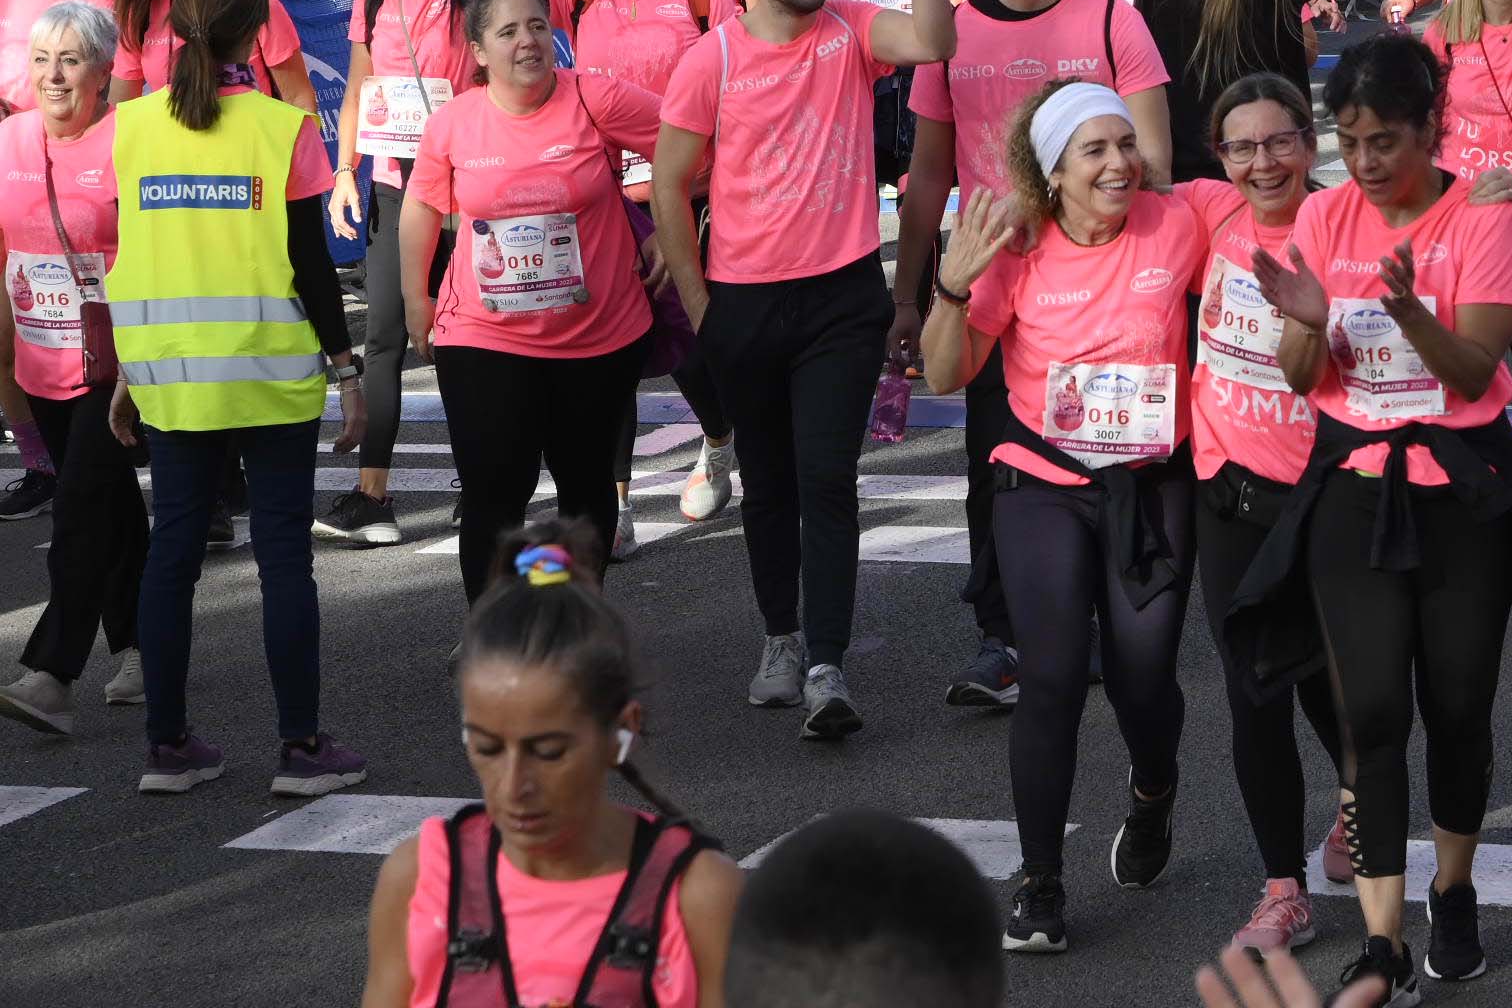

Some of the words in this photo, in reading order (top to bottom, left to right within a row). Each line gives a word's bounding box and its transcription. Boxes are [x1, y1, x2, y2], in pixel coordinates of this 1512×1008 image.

[816, 32, 850, 61] DKV
[1057, 56, 1099, 72] DKV
[726, 74, 779, 93] OYSHO
[464, 155, 505, 168] OYSHO
[141, 184, 248, 203] VOLUNTARIS
[505, 232, 543, 243] ASTURIANA
[508, 254, 544, 269] 016
[516, 272, 538, 281] 7685
[36, 292, 70, 306] 016
[545, 292, 574, 302] Santand
[1036, 291, 1091, 305] OYSHO
[43, 310, 64, 318] 7684
[1224, 311, 1259, 334] 016
[1234, 334, 1244, 346] 12
[1354, 346, 1392, 363] 016
[1250, 369, 1285, 383] Santande
[1210, 376, 1316, 426] SUMA
[1391, 398, 1433, 409] Santander
[1088, 408, 1130, 425] 016
[1094, 430, 1121, 440] 3007
[1104, 444, 1114, 452] LA
